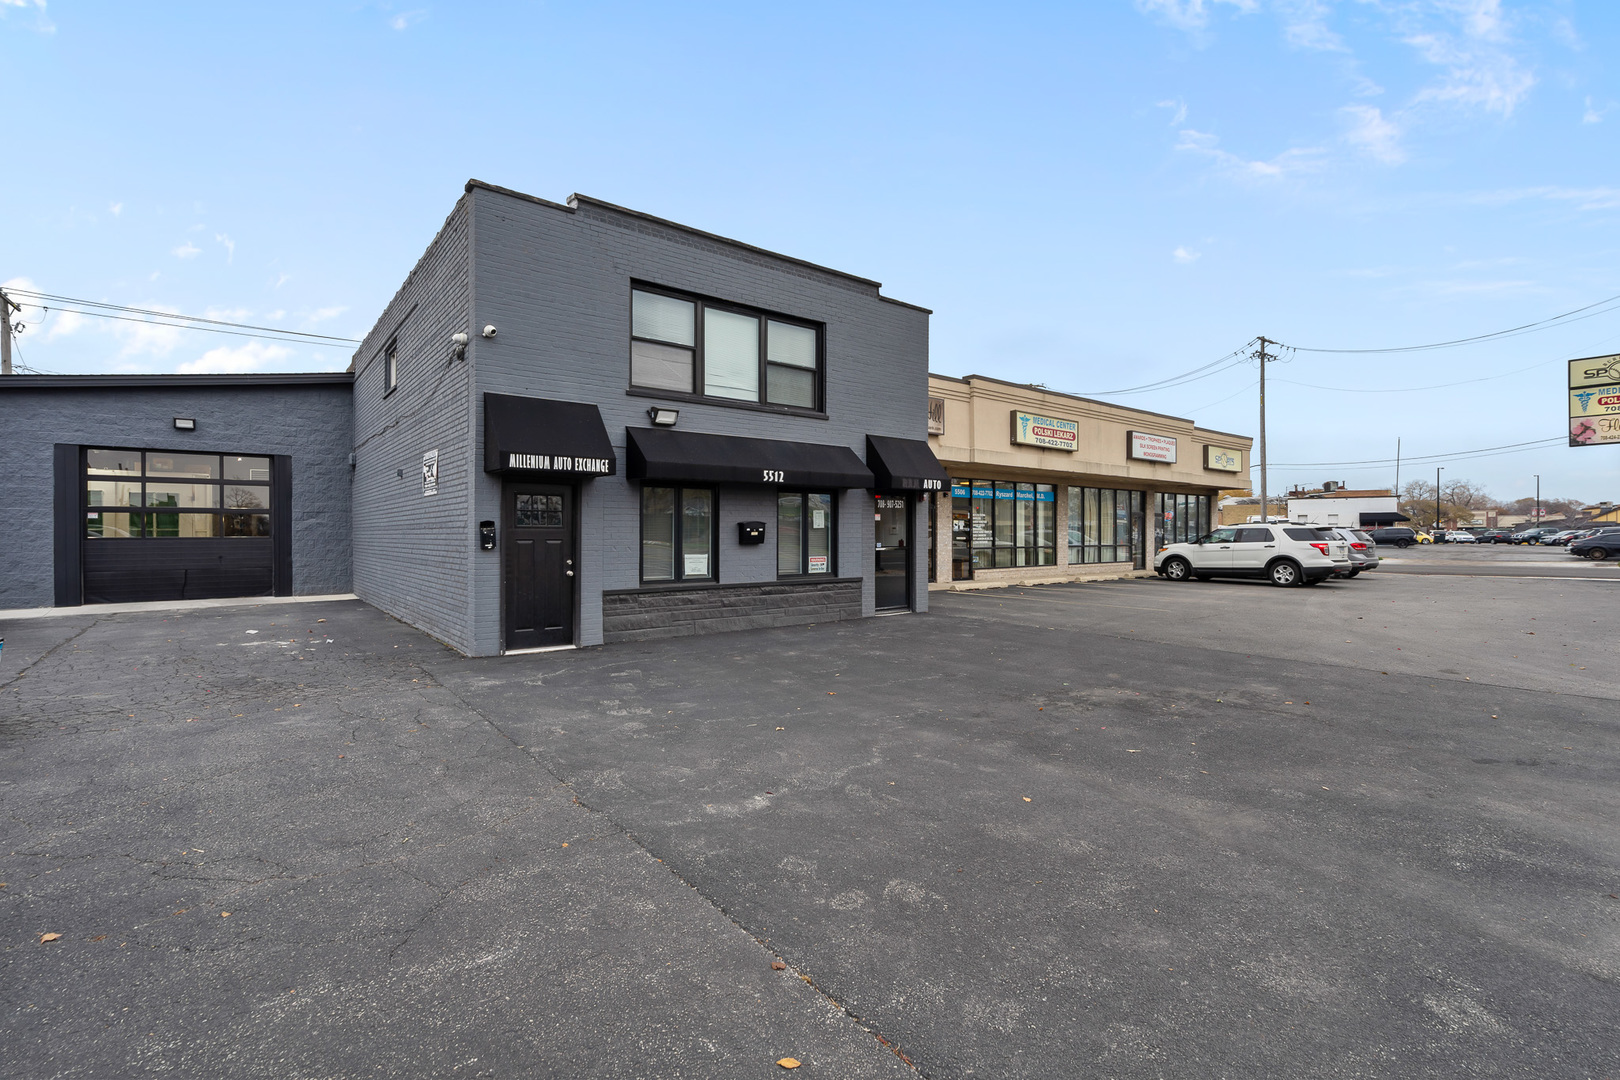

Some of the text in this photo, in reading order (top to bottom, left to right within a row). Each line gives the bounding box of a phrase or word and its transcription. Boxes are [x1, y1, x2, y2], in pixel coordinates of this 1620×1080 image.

[1601, 396, 1620, 405] POL
[1033, 416, 1076, 431] MEDICAL CENTER
[1598, 418, 1620, 433] Fl
[1034, 427, 1074, 440] POLSKI LEKARZ
[1035, 437, 1073, 448] 708-422-7702
[509, 453, 609, 473] MILLENIUM AUTO EXCHANGE
[763, 470, 784, 483] 5512
[923, 479, 942, 490] AUTO
[995, 490, 1013, 498] Ryszard
